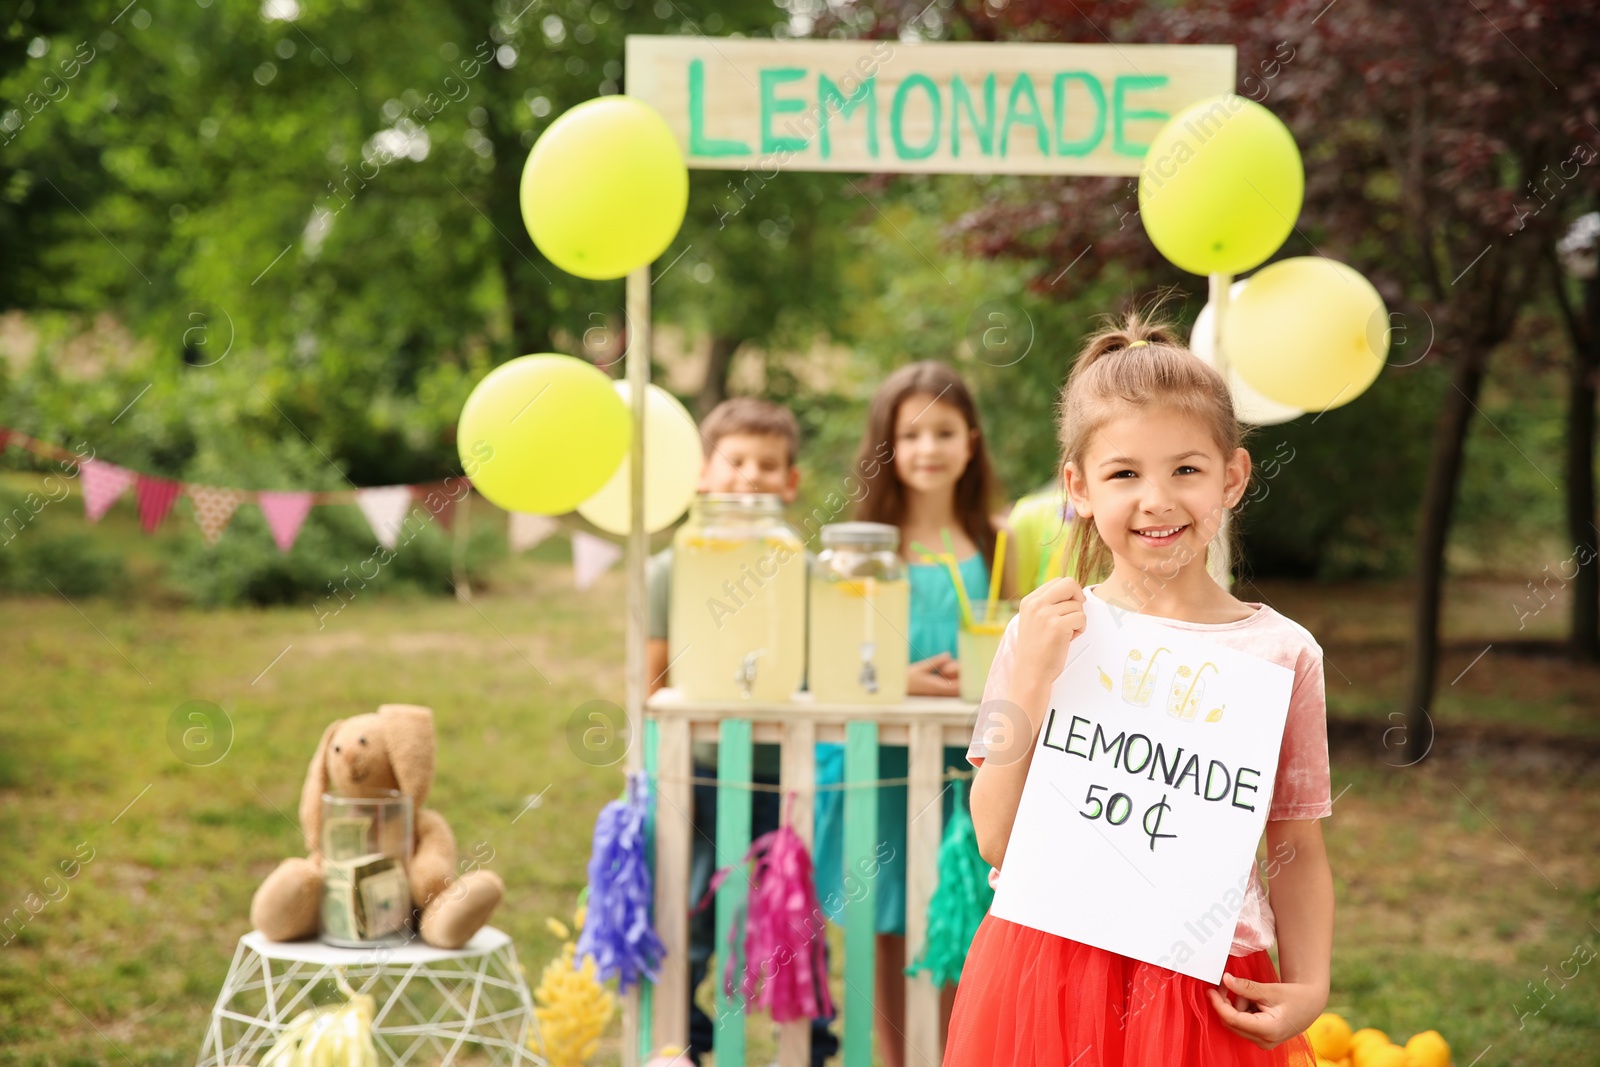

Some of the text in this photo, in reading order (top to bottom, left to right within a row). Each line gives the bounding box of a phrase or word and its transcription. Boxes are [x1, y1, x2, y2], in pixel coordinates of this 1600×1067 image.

[688, 58, 1170, 160] LEMONADE
[1043, 708, 1261, 813] LEMONADE
[1079, 784, 1133, 826] 50
